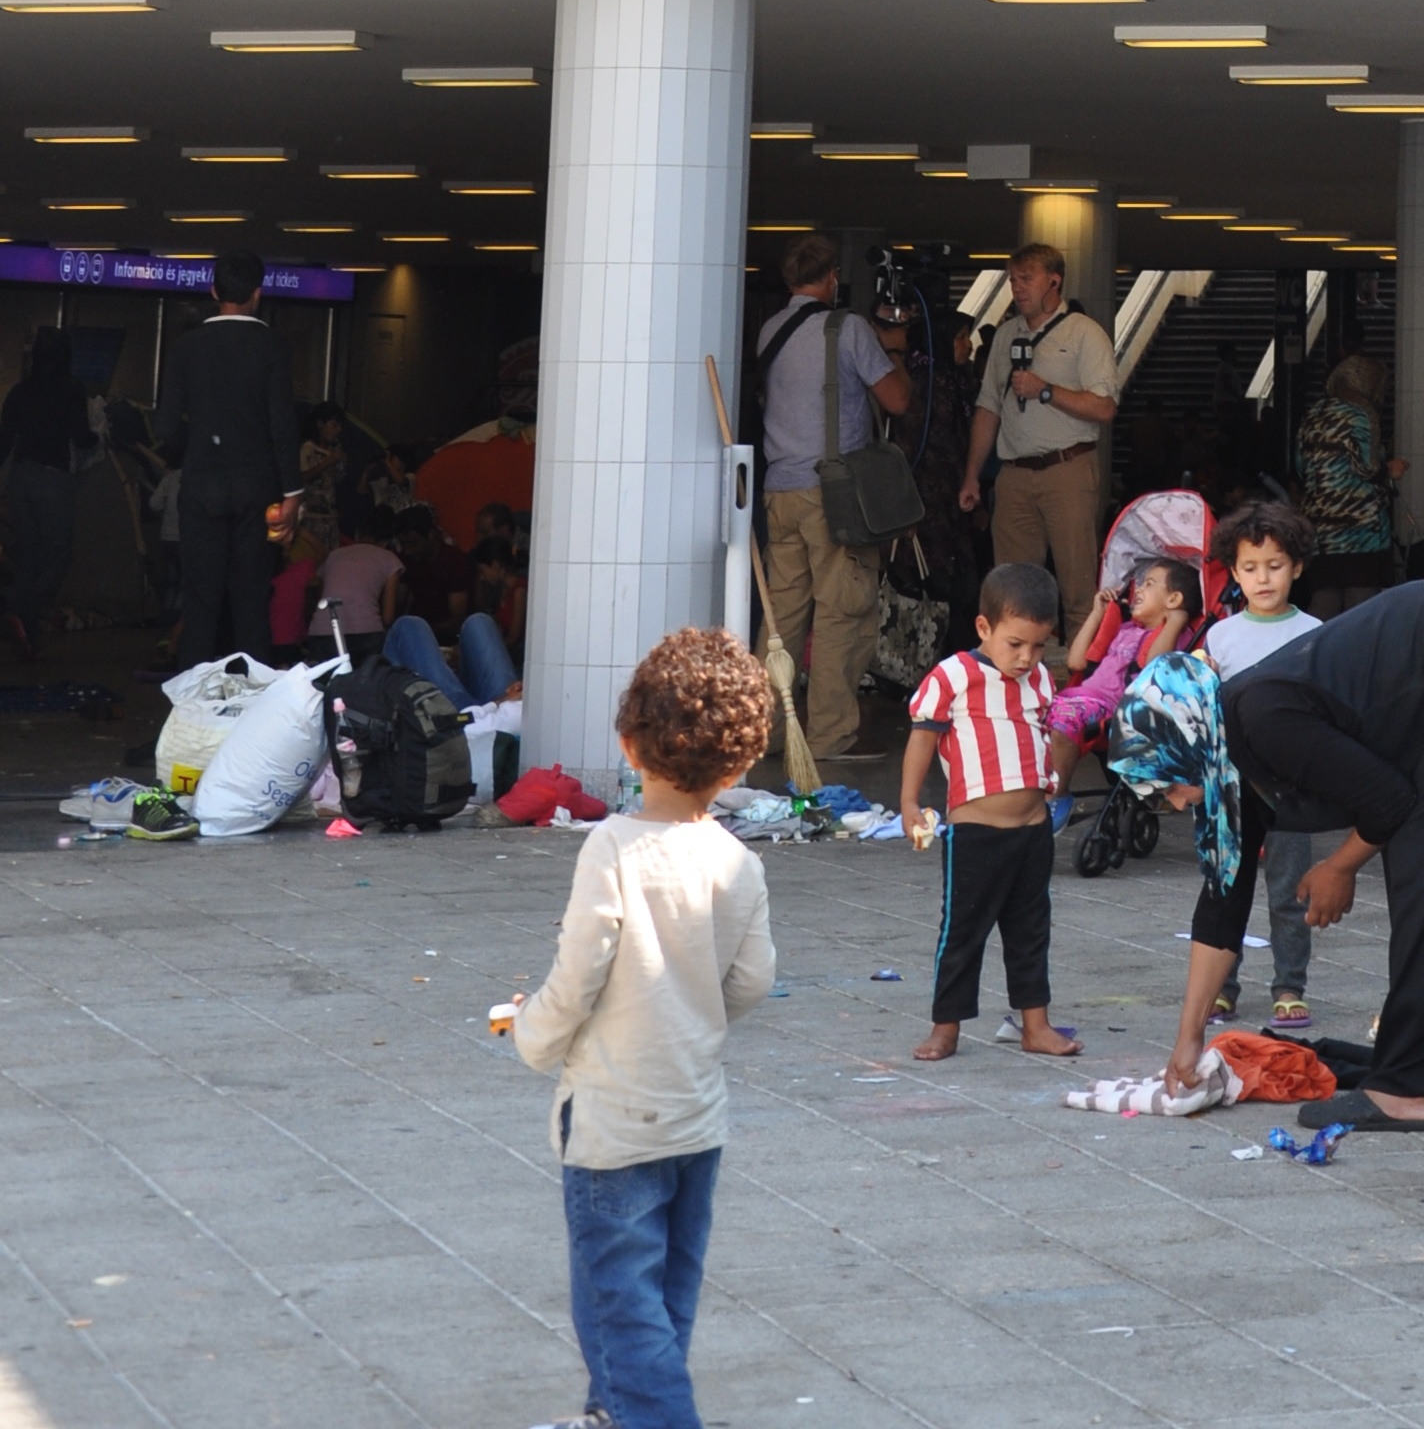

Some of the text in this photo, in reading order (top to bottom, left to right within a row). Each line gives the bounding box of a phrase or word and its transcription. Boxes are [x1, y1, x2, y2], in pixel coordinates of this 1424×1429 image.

[114, 260, 164, 281] Információ
[177, 264, 214, 287] jegyek/
[275, 272, 300, 289] tickets
